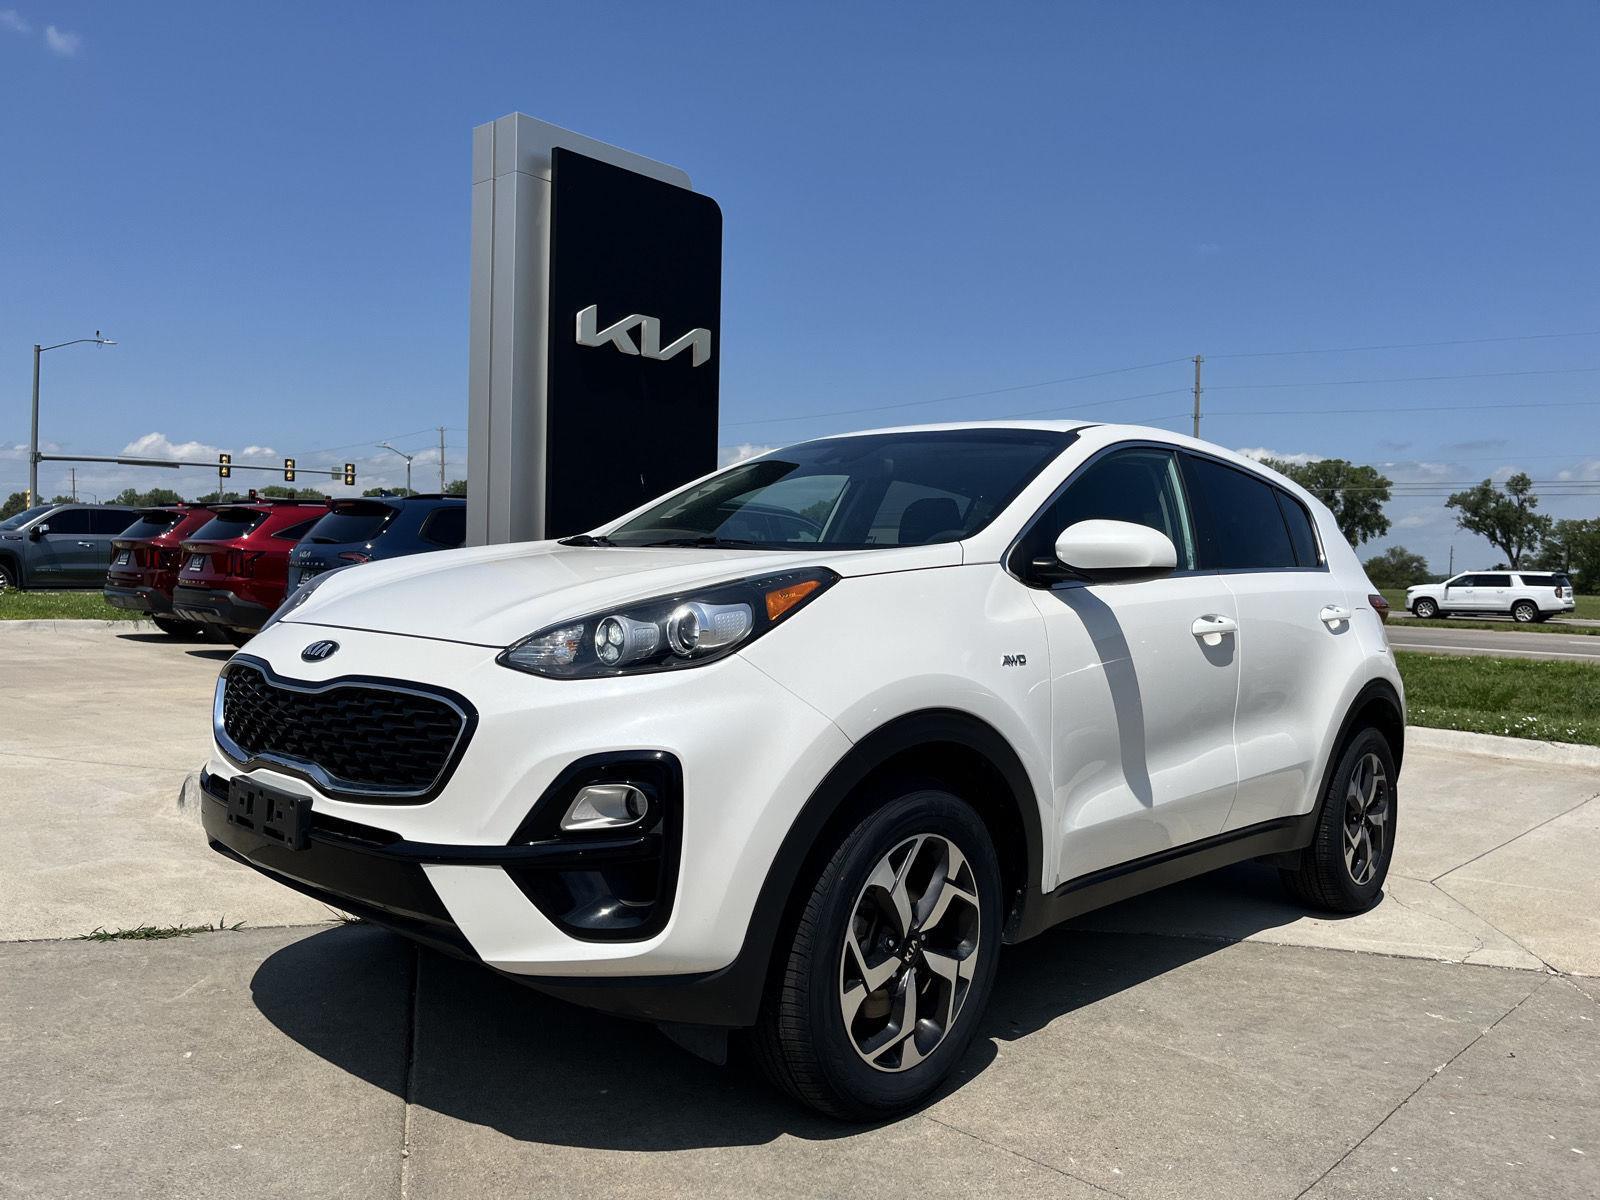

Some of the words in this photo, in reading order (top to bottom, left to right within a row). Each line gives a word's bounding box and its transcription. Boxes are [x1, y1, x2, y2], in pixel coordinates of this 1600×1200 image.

[576, 304, 711, 367] KIA
[303, 641, 333, 658] KIA
[1002, 654, 1027, 667] AWD
[904, 939, 918, 962] KIA
